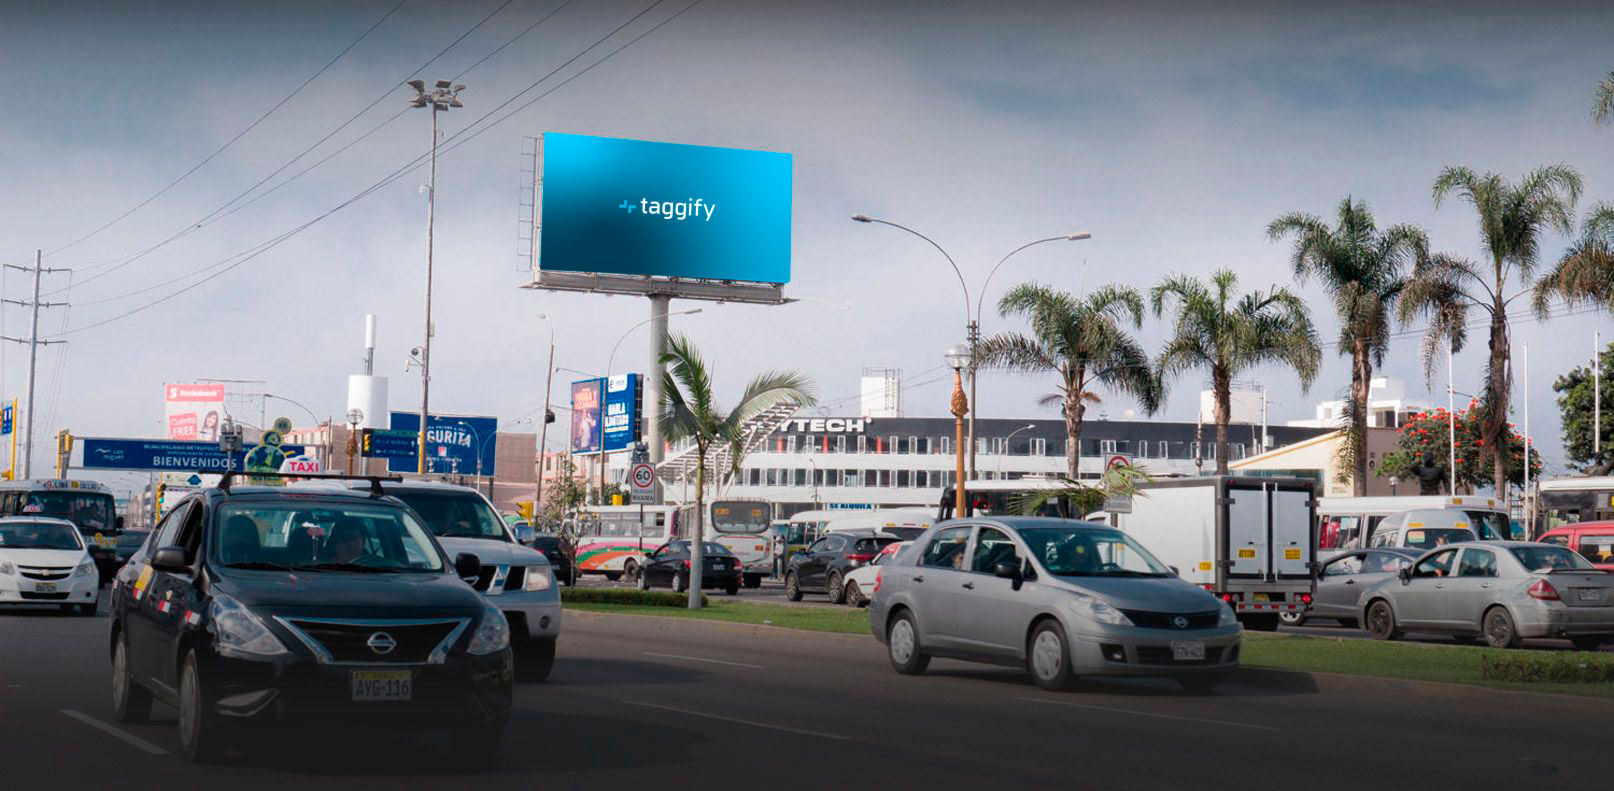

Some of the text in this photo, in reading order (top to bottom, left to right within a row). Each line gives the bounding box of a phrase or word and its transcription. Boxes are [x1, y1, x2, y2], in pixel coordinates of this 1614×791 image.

[640, 198, 716, 222] taggify
[172, 426, 195, 436] FREE
[780, 419, 864, 432] YTECH
[426, 430, 472, 448] GURITA
[152, 456, 237, 468] BIENVENIDOS
[289, 462, 319, 472] TAXI
[636, 470, 650, 480] 60
